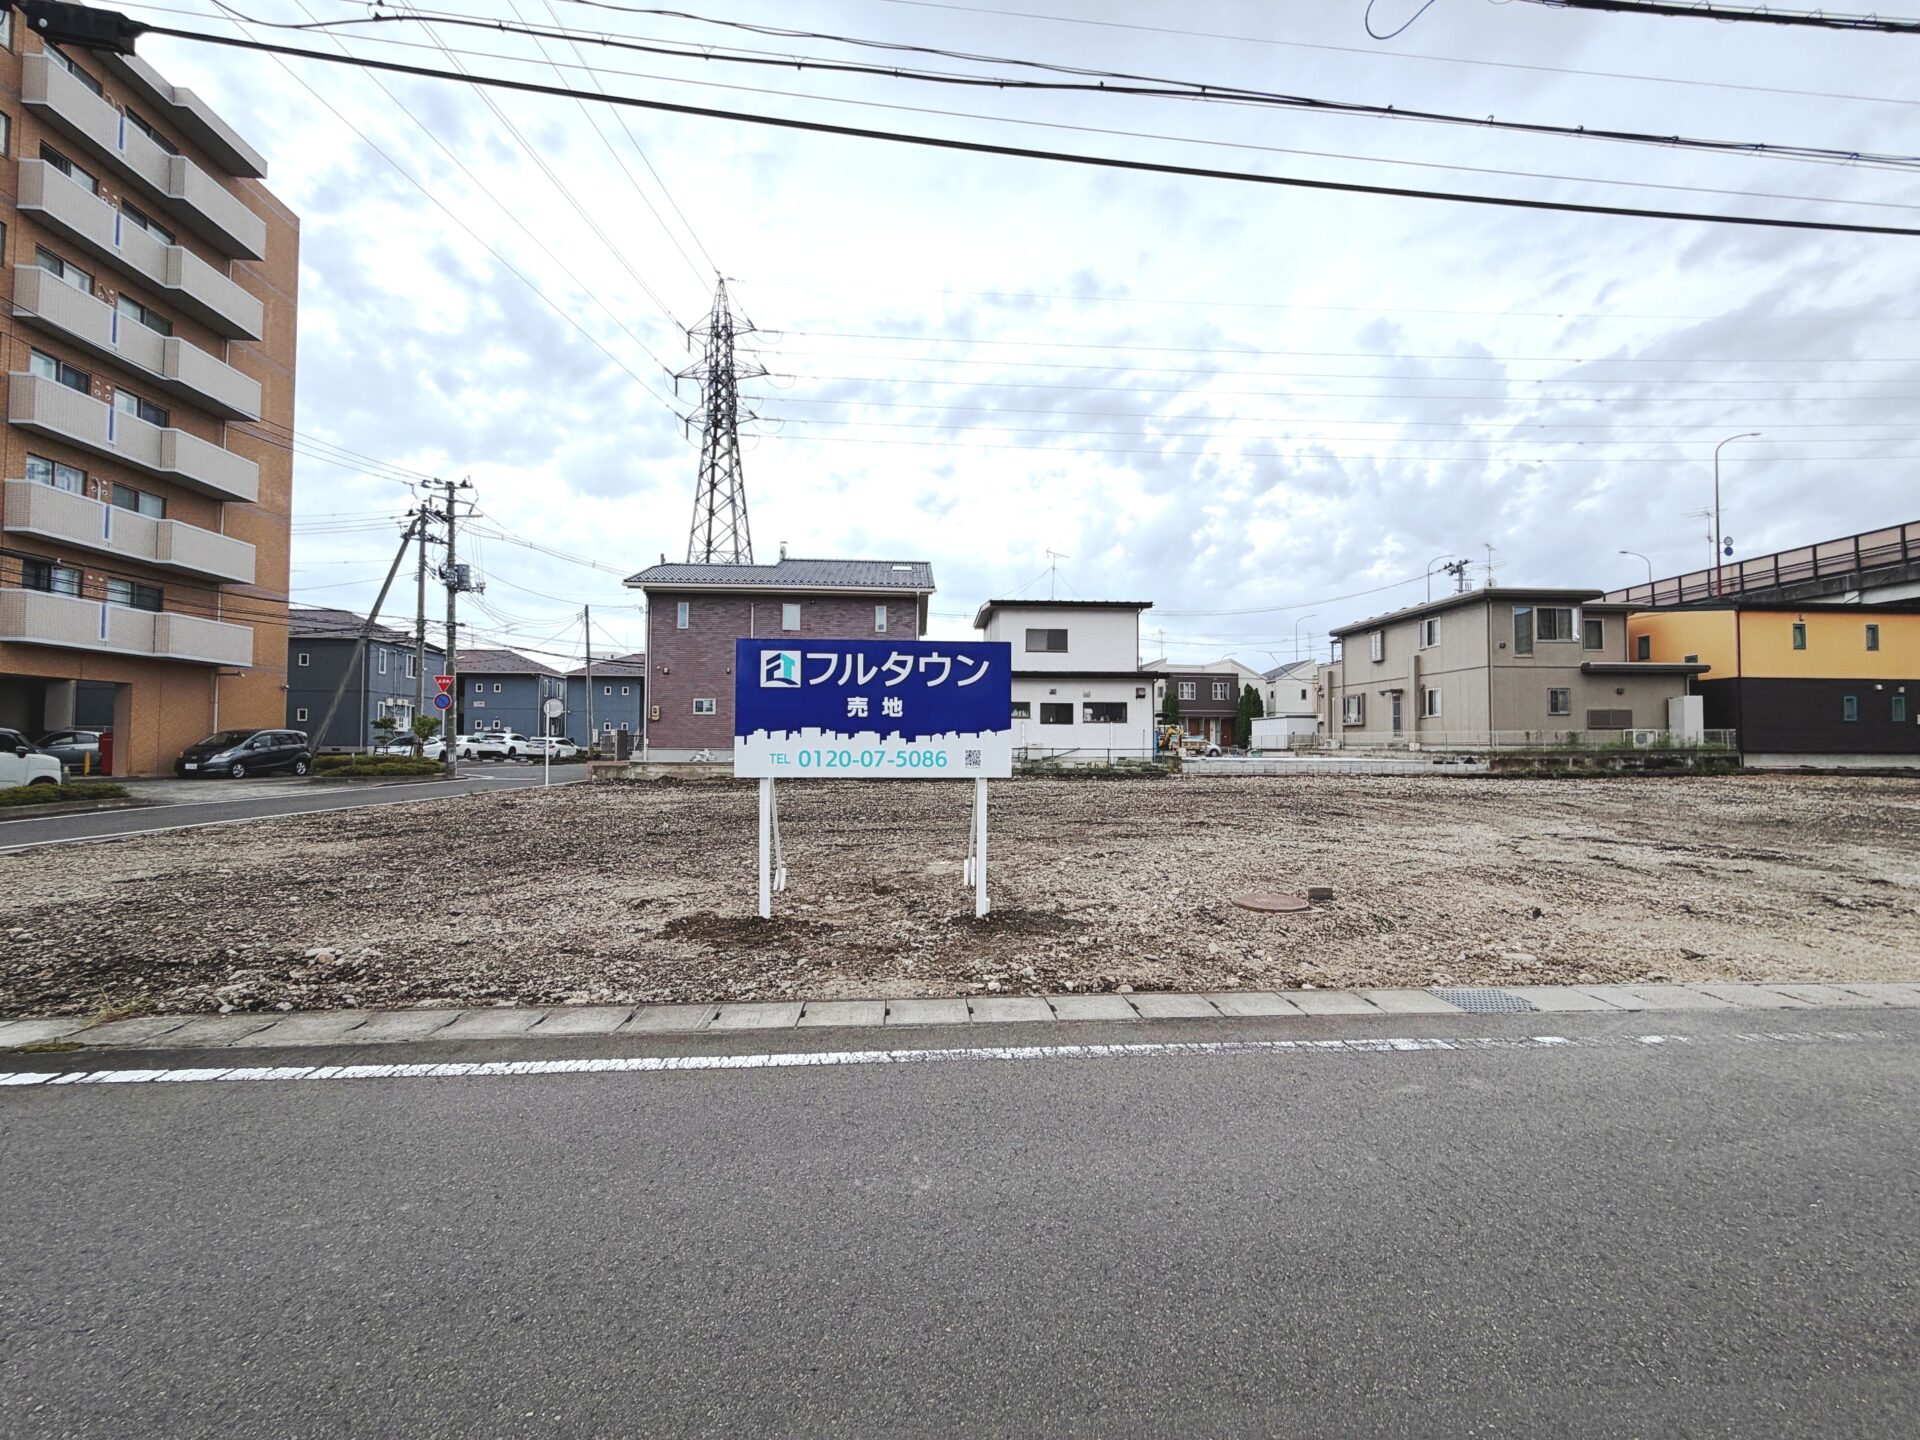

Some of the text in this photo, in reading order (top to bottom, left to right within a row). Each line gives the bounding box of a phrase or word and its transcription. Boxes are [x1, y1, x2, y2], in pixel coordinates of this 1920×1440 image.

[806, 651, 990, 688] フルタウン
[769, 750, 948, 768] TEL 0120-07-5086
